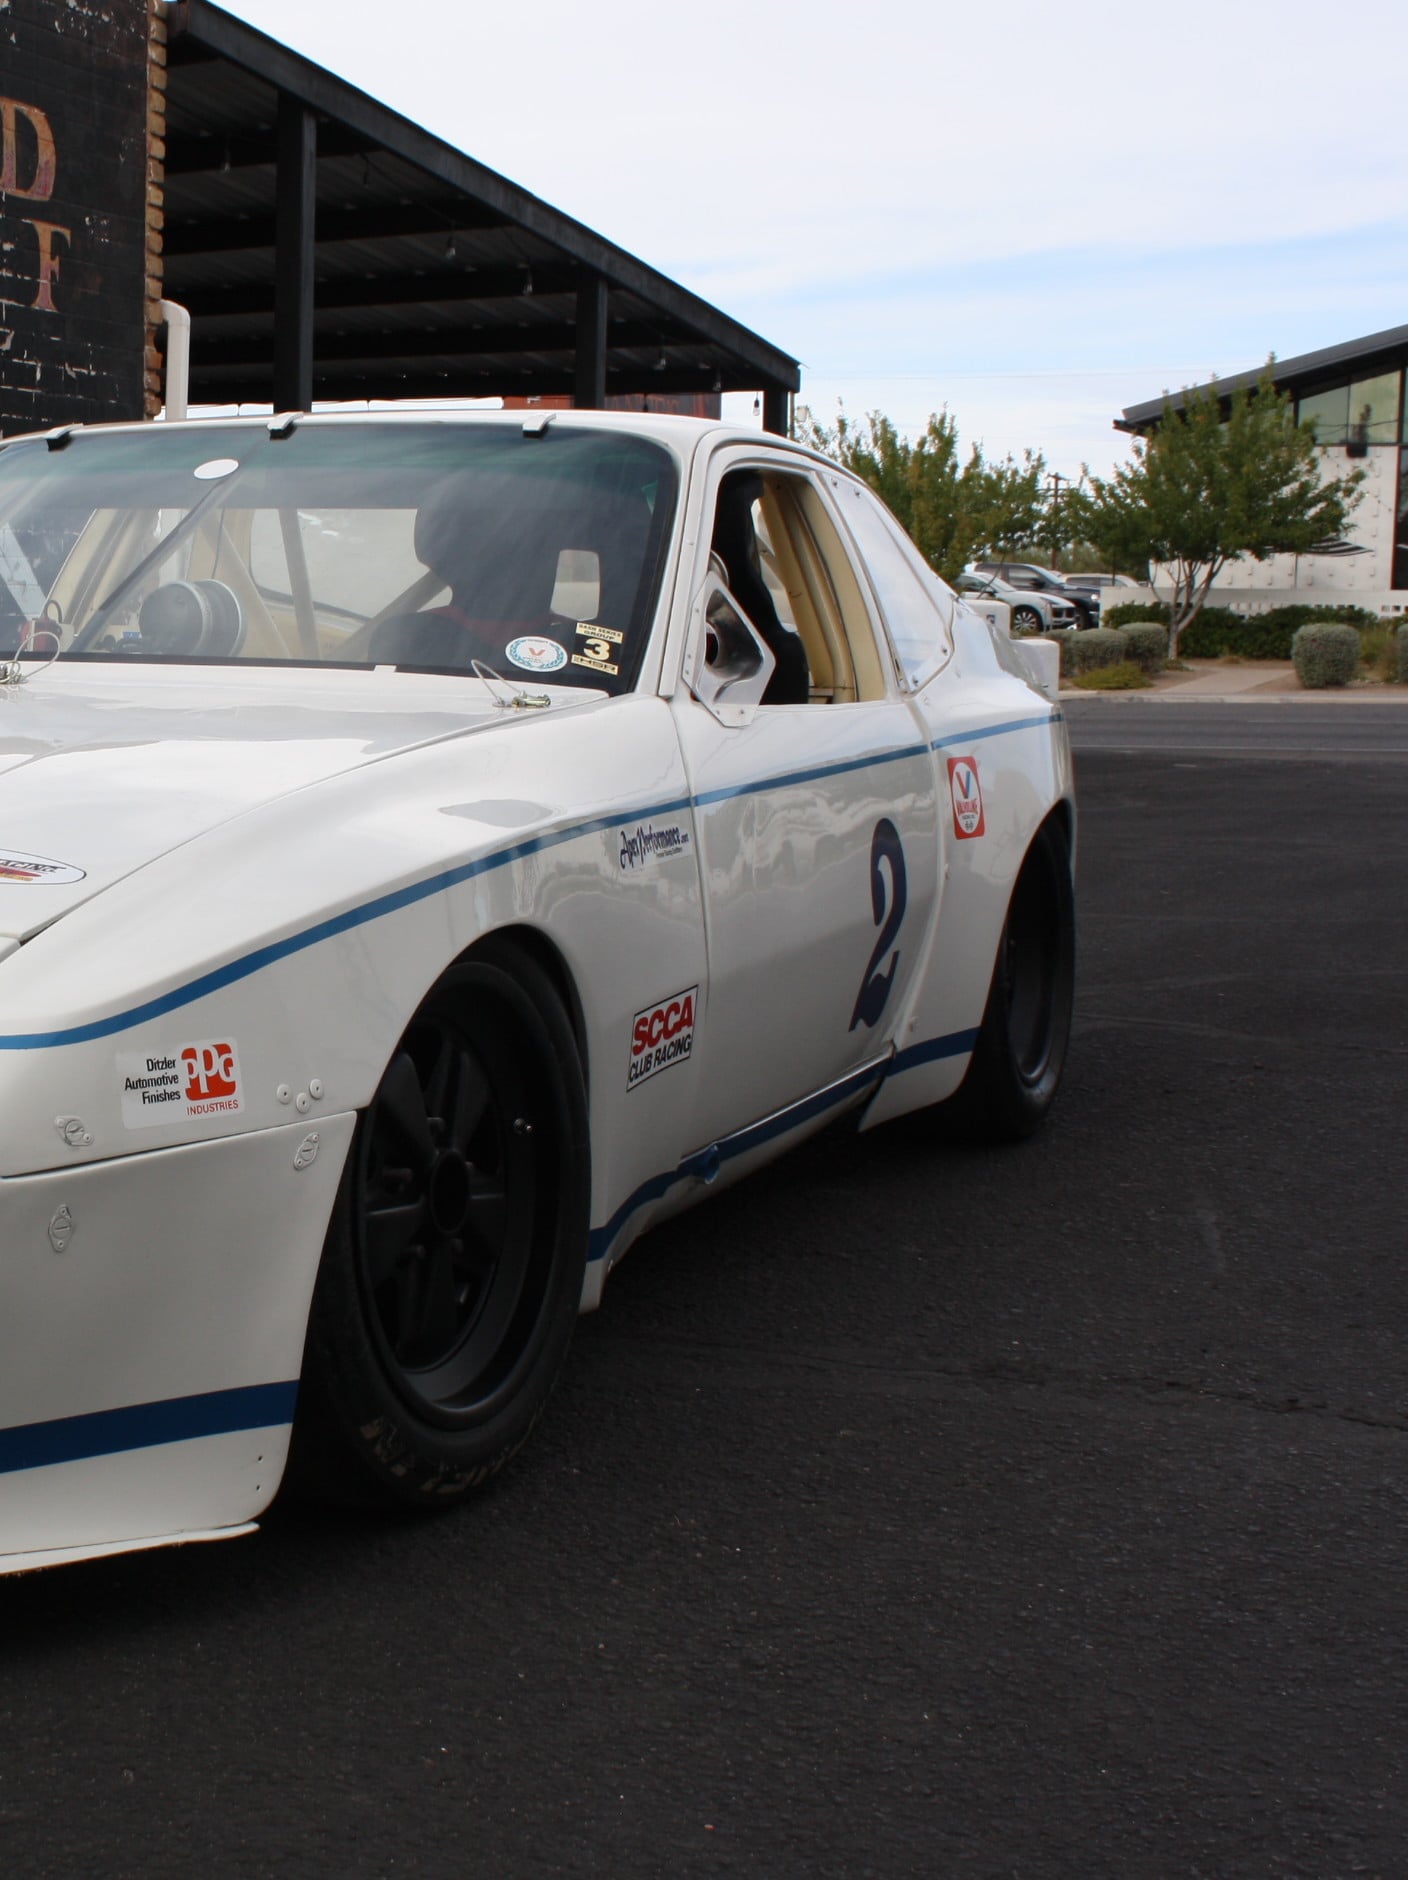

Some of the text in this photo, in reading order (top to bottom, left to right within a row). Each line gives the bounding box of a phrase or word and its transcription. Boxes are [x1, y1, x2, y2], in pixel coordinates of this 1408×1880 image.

[22, 219, 72, 313] F
[584, 638, 610, 660] 3
[848, 817, 908, 1032] 2
[632, 994, 693, 1057] SCCA
[146, 1056, 177, 1072] Ditzler
[629, 1033, 692, 1083] CLUB RACING
[124, 1072, 180, 1091] Automotive
[142, 1089, 181, 1105] Finishes
[187, 1099, 240, 1116] INDUSTRIES
